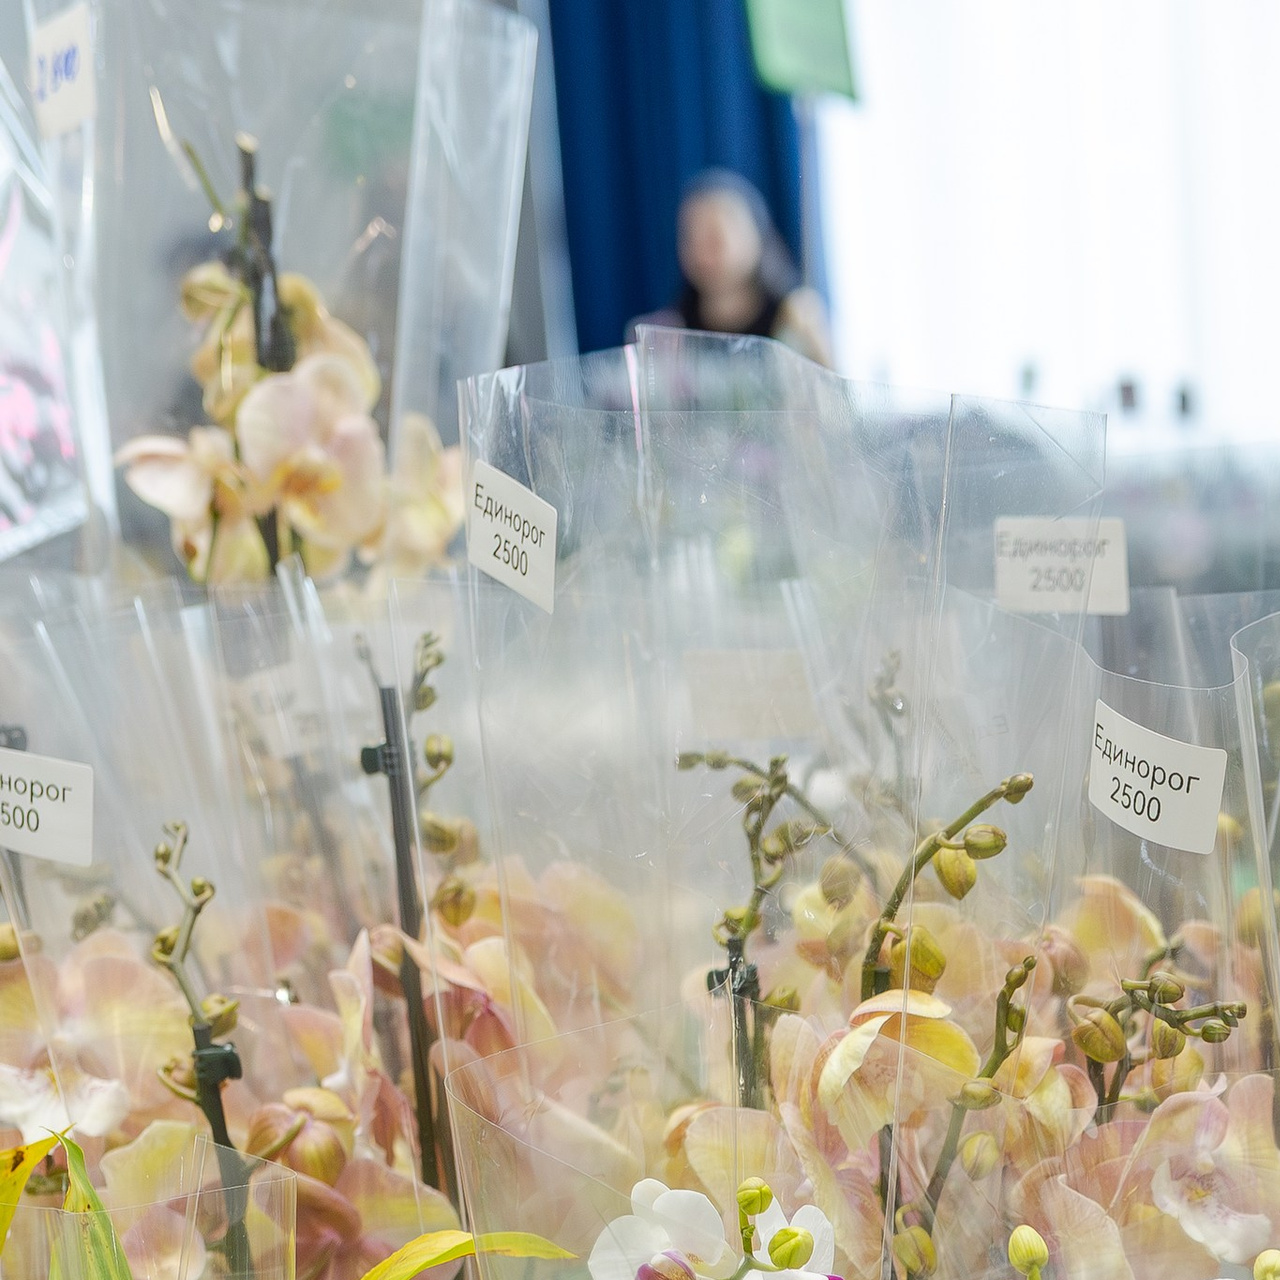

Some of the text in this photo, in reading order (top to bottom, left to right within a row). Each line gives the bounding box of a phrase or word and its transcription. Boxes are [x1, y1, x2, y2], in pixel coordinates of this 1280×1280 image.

[474, 482, 546, 548] Единорог
[492, 533, 528, 576] 2500
[1094, 722, 1200, 794] Единорог
[1110, 776, 1161, 822] 2500
